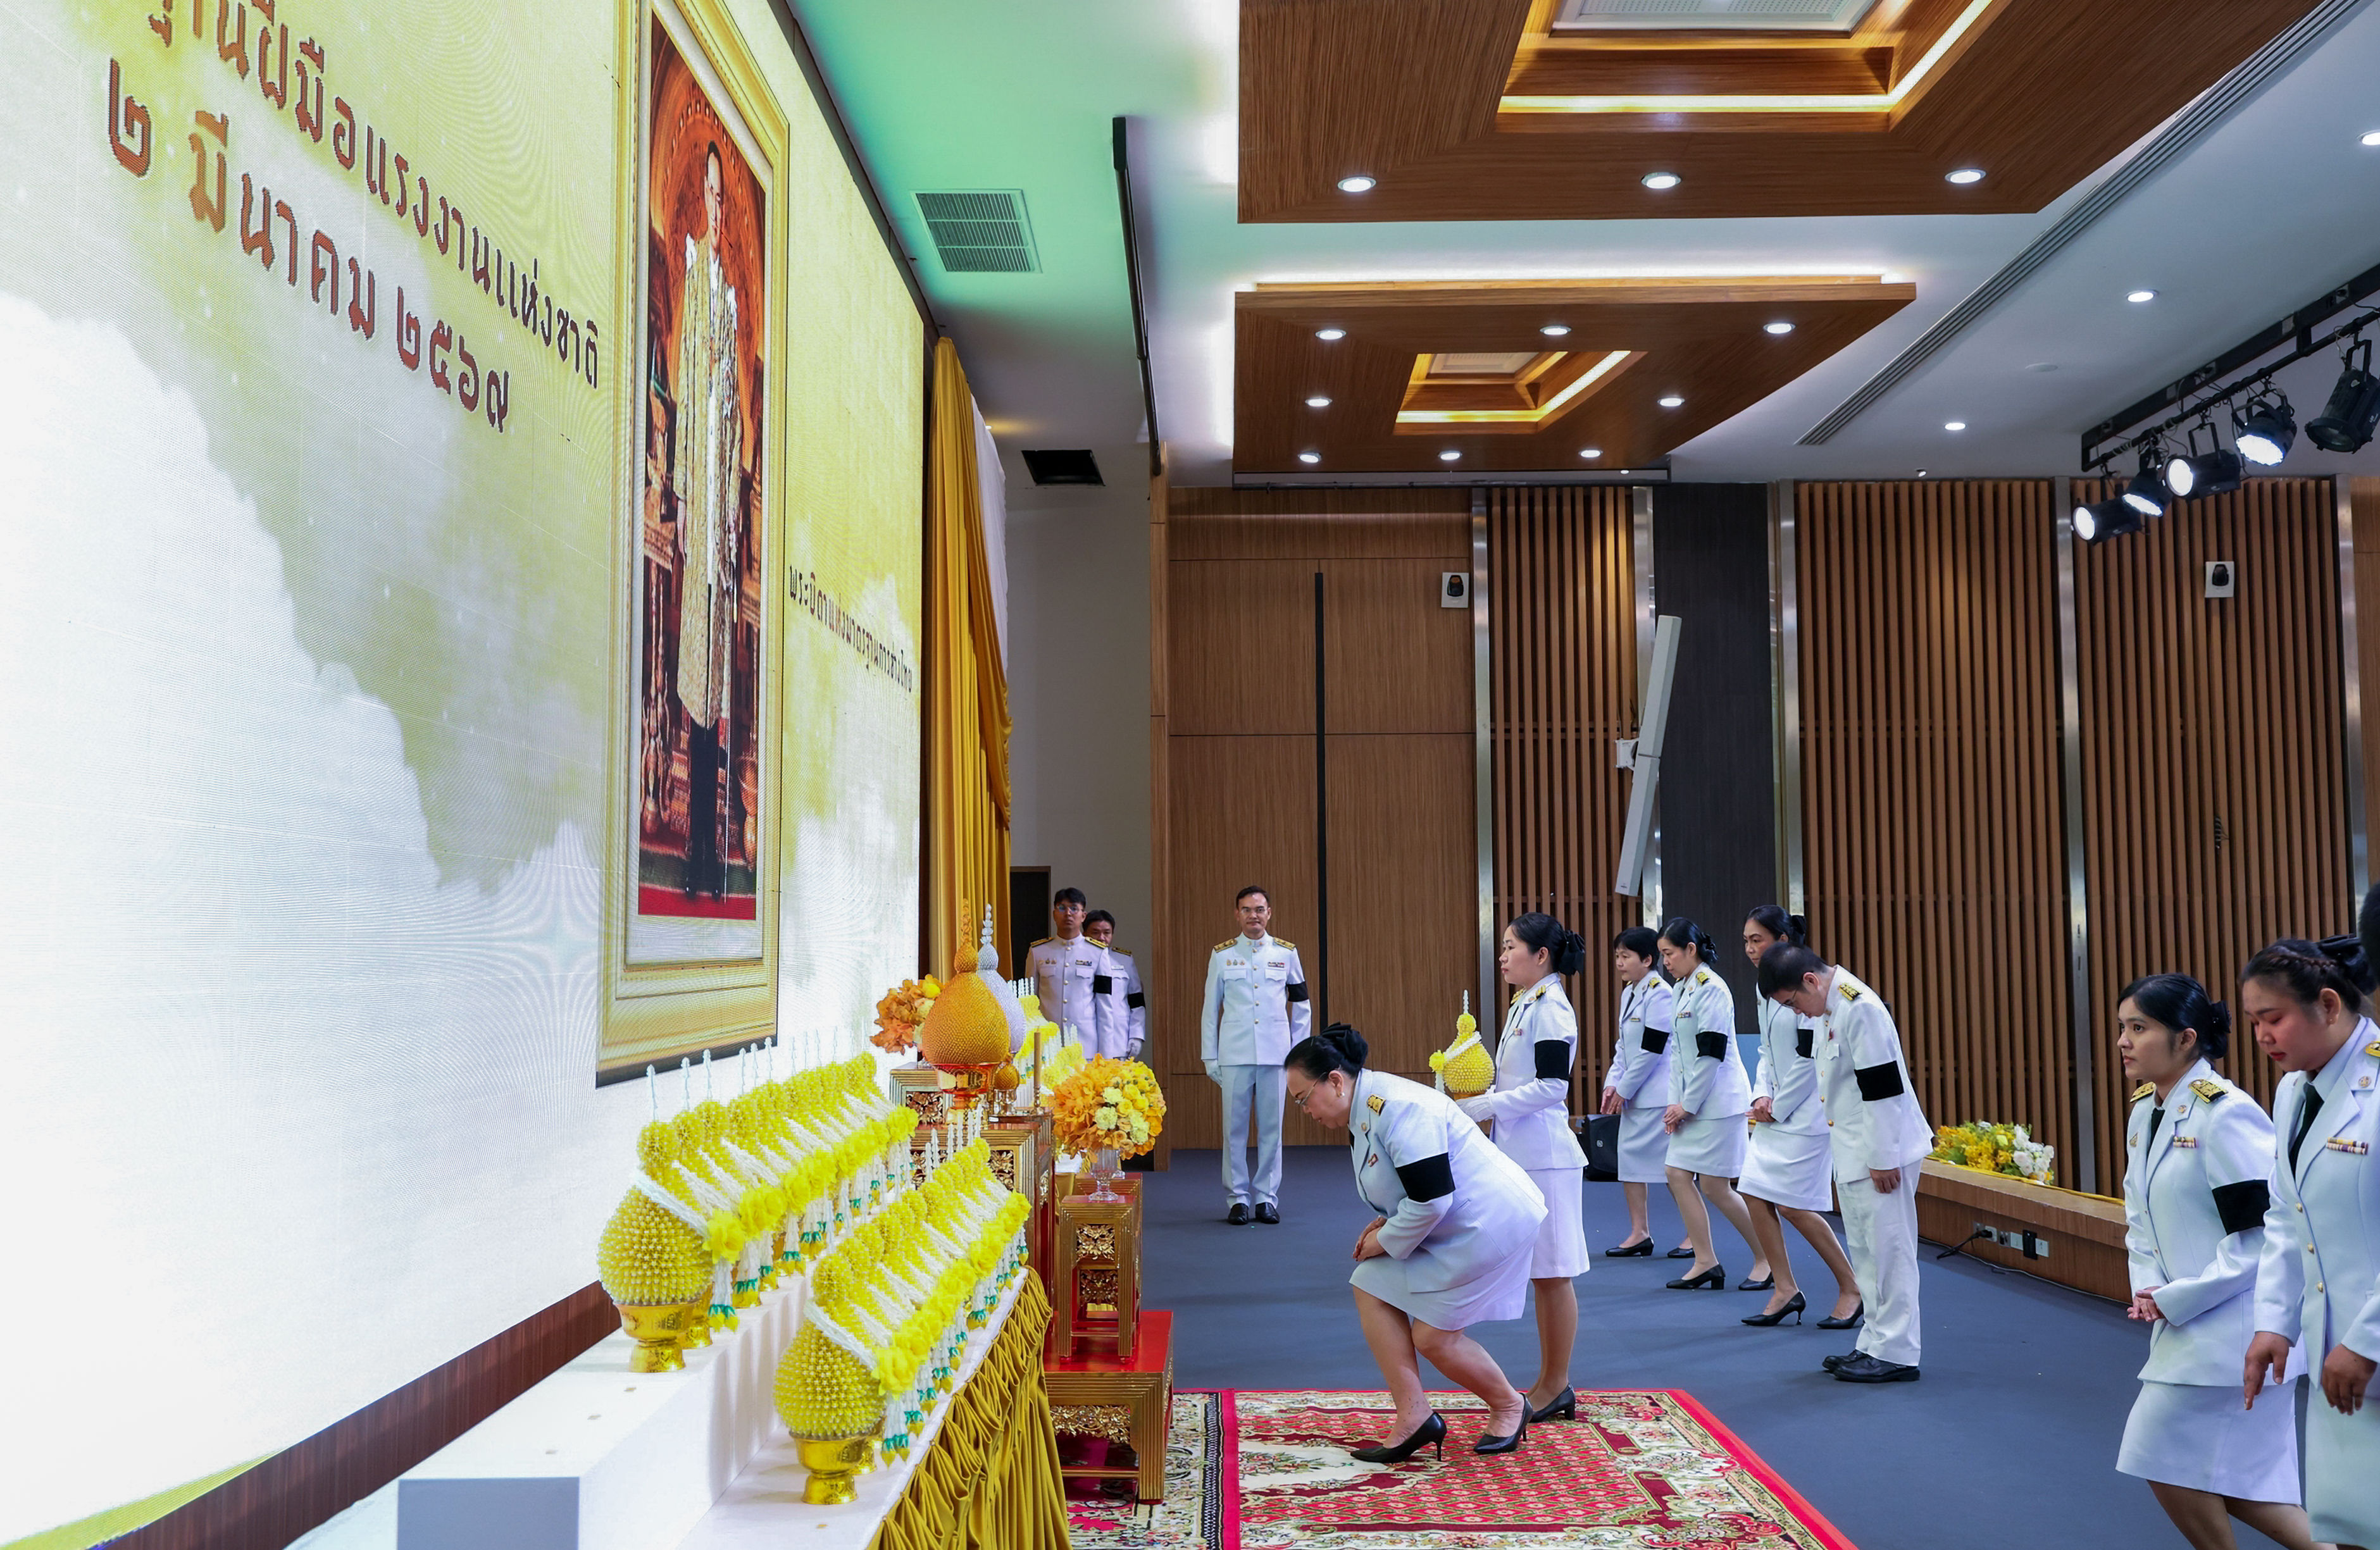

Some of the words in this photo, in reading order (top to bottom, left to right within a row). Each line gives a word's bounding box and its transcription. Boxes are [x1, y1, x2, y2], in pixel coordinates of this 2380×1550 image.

[109, 58, 151, 178] ๒
[188, 110, 375, 340] มีนาคม
[397, 286, 509, 433] ๒๕๖๙
